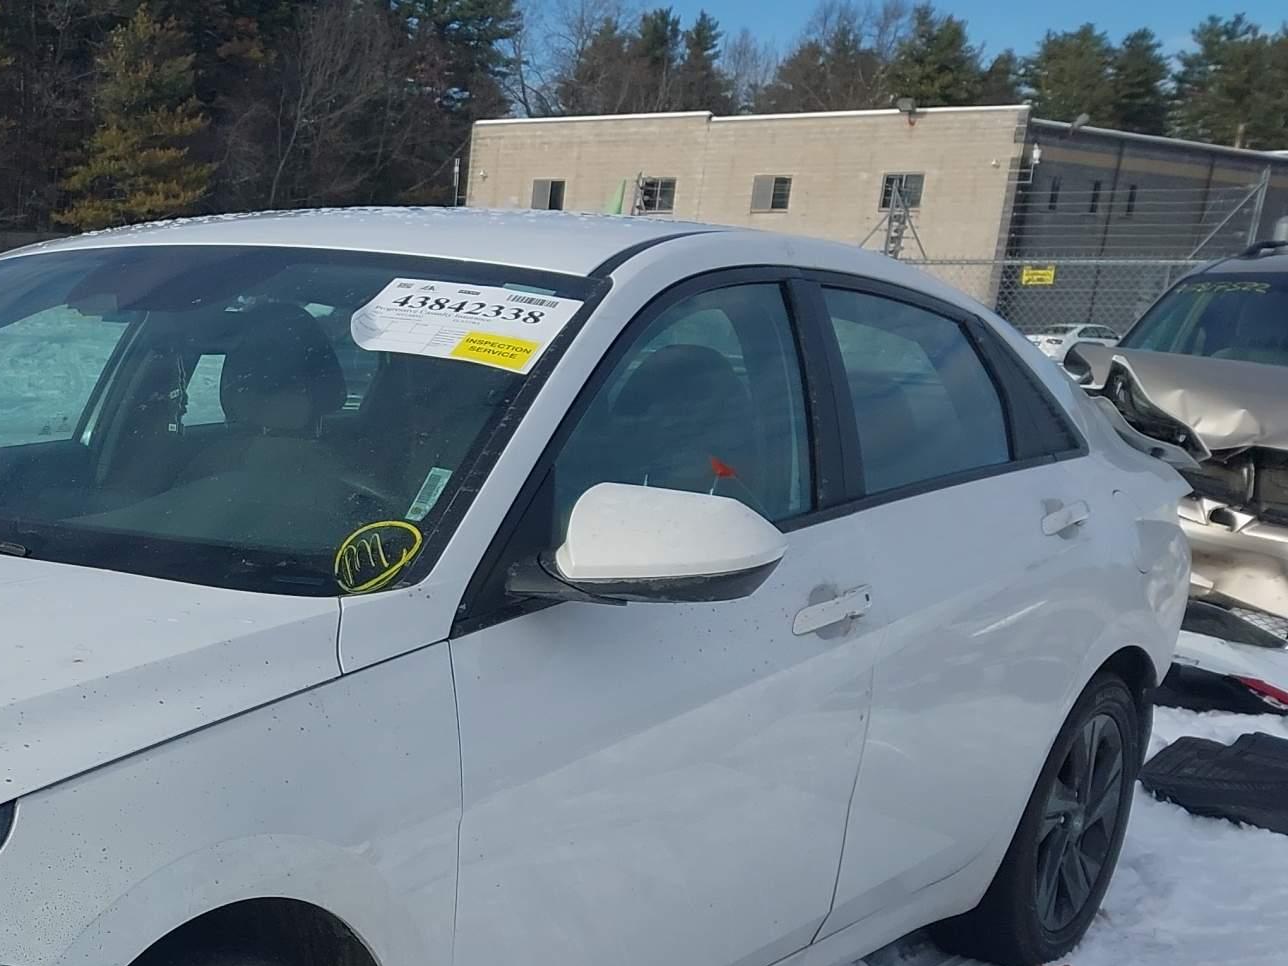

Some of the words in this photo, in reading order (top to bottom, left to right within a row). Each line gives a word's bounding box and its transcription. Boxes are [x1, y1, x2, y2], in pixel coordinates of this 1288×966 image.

[392, 295, 545, 324] 43842338
[466, 337, 532, 354] INSPECTION
[468, 345, 518, 360] SERVICE
